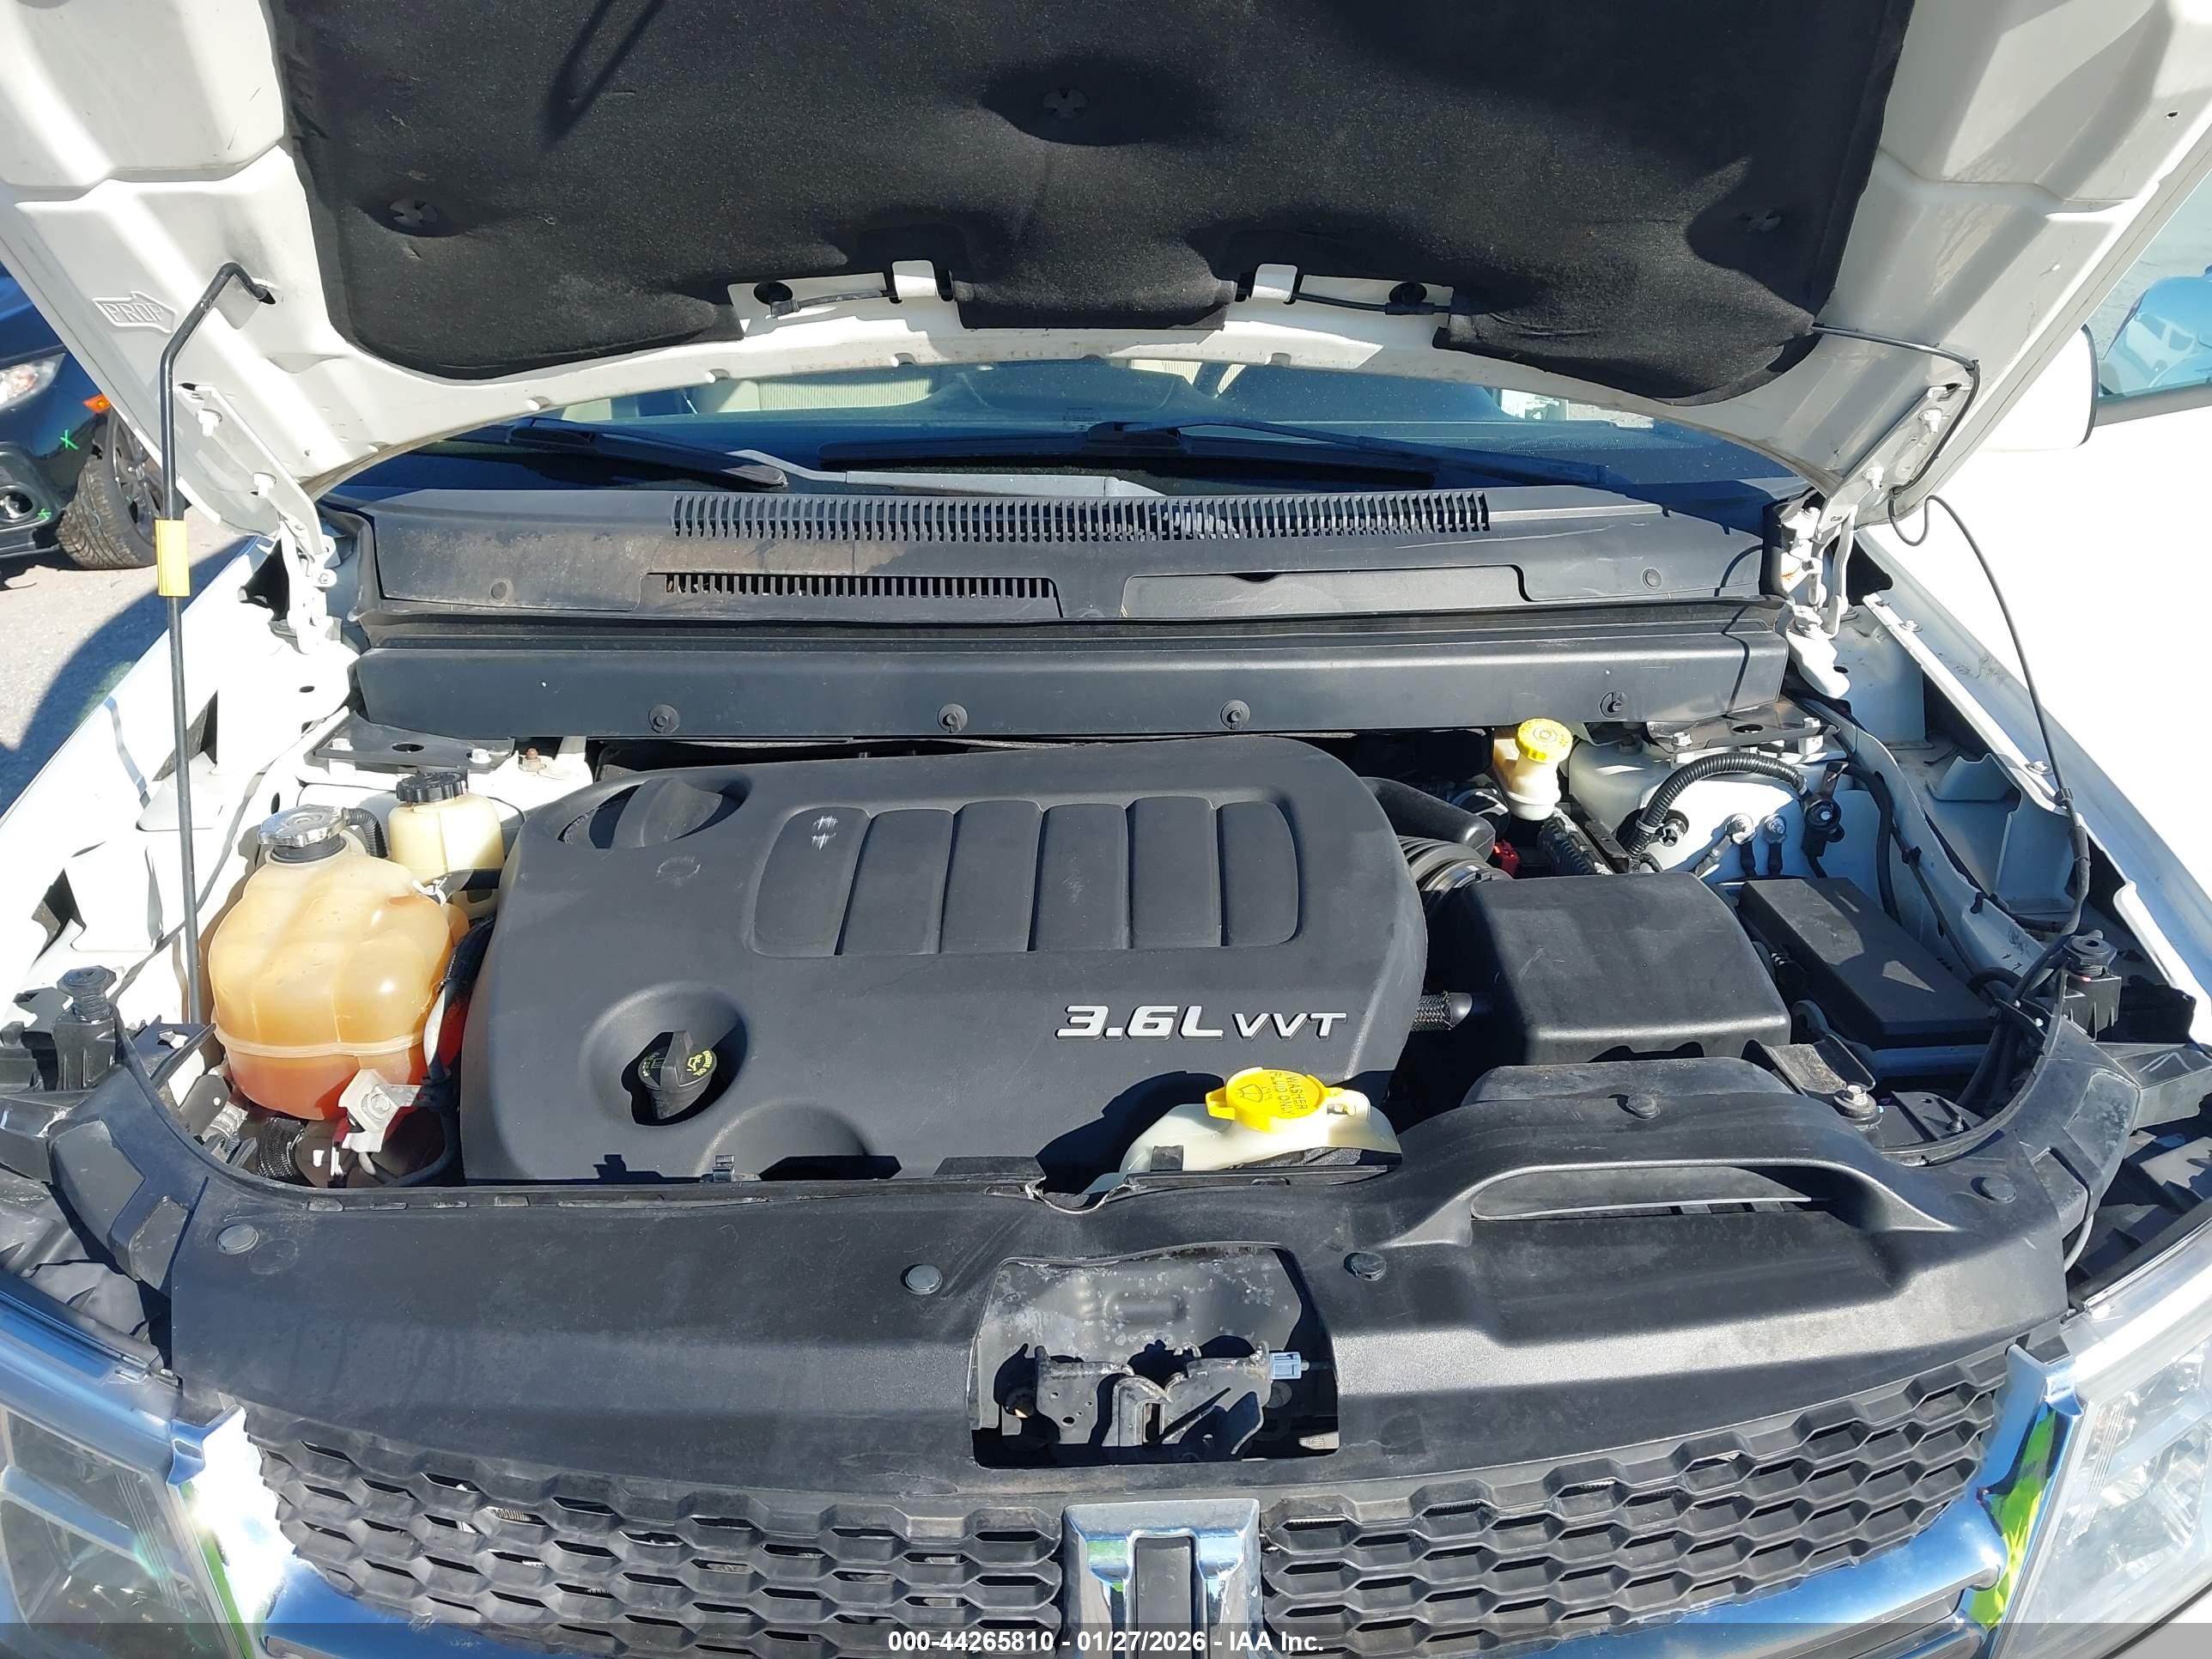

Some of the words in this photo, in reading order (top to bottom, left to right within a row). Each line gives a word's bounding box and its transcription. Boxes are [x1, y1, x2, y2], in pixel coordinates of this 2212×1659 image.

[101, 302, 164, 322] PROP
[1056, 1006, 1224, 1039] 3.6L
[1231, 1012, 1347, 1039] VVT
[693, 1067, 707, 1076] OIL
[1286, 1075, 1309, 1110] WASHER
[1279, 1094, 1295, 1115] ONLY
